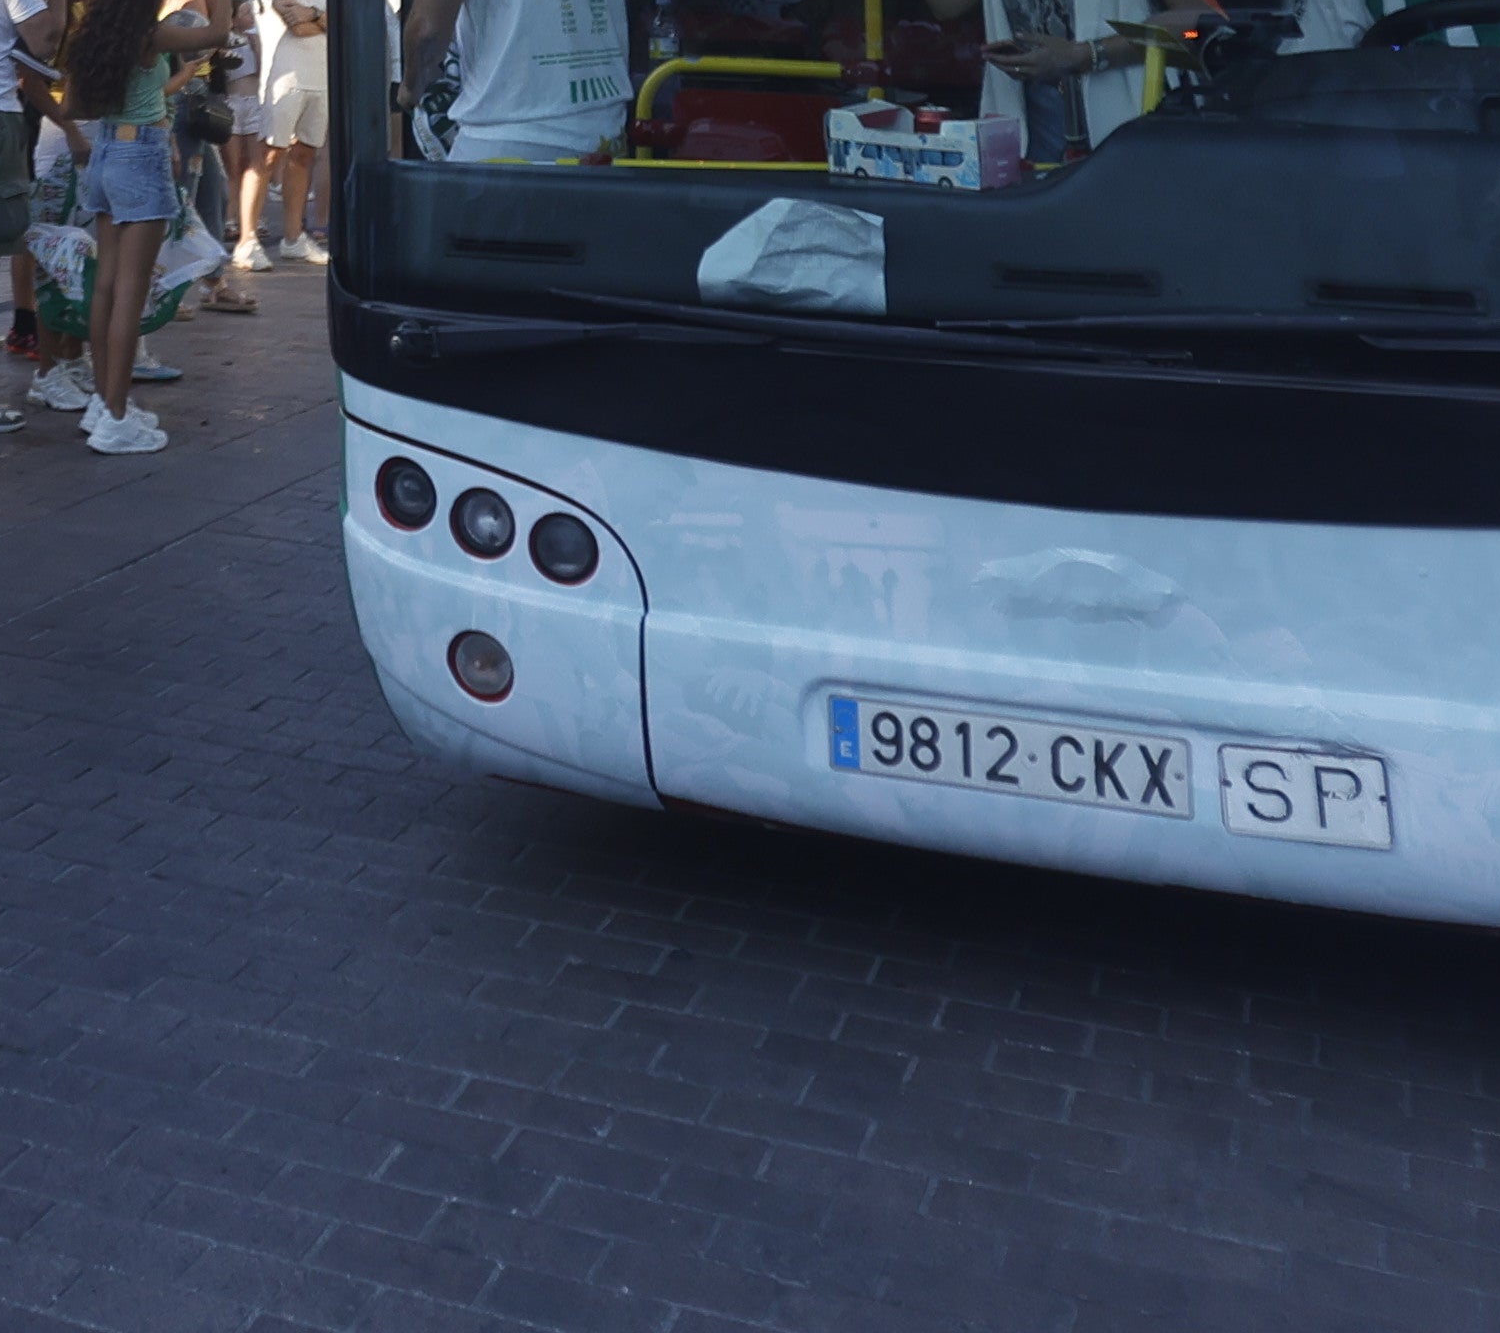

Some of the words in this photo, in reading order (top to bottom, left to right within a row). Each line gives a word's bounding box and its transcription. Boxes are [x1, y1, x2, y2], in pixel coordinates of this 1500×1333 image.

[840, 739, 853, 759] E
[870, 711, 1020, 787] 9812
[1050, 734, 1177, 809] CKX
[1243, 761, 1363, 830] SP
